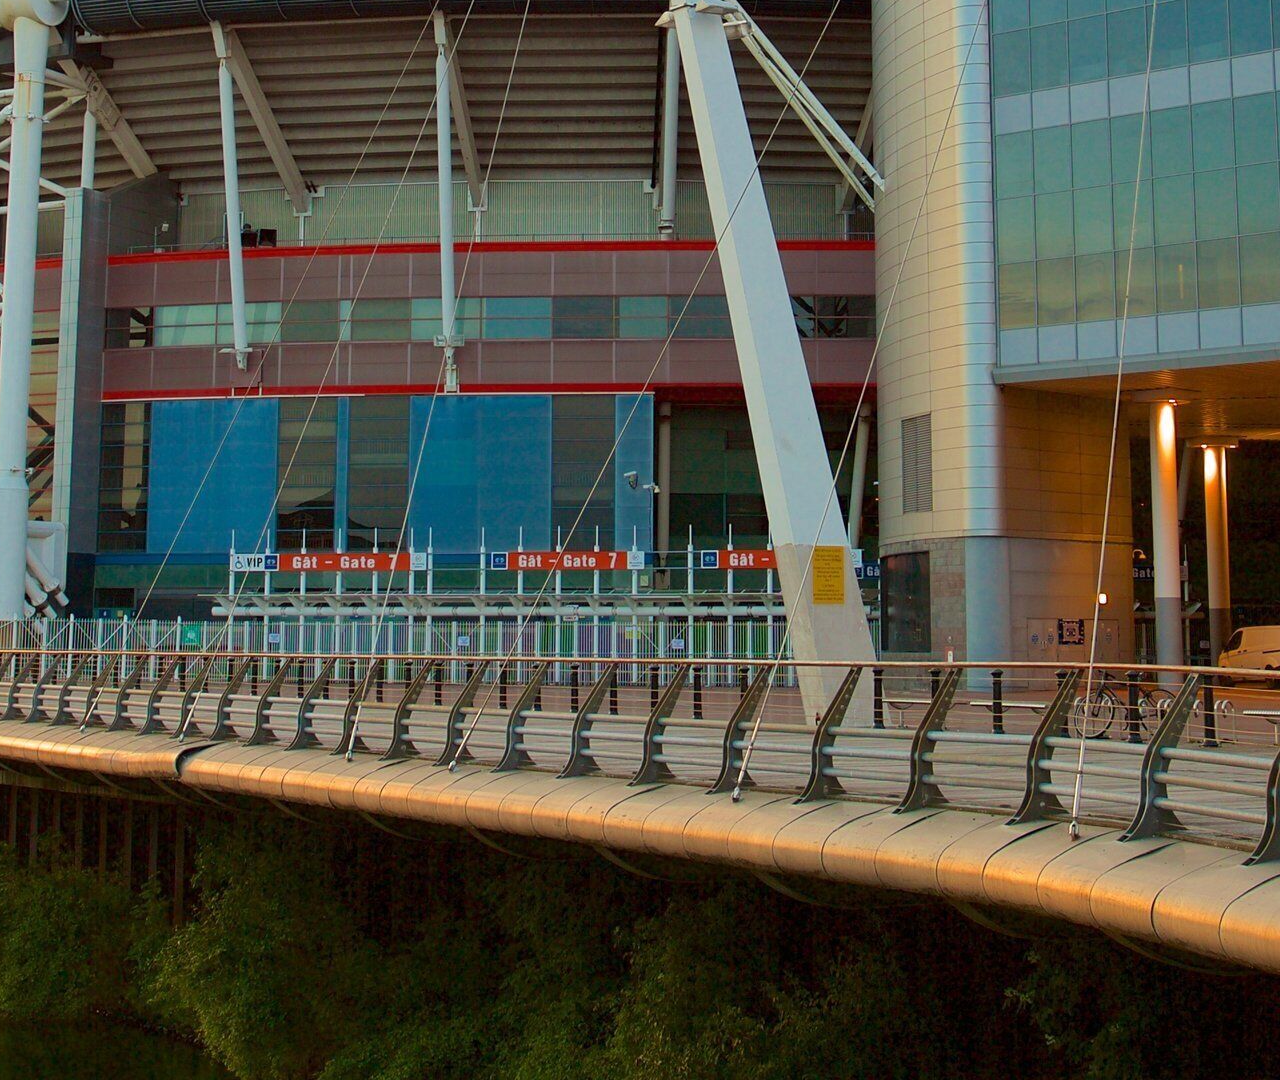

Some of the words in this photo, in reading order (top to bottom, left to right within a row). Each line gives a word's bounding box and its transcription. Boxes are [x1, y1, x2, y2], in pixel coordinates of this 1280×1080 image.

[247, 557, 263, 568] VIP
[293, 556, 318, 569] Gât
[340, 556, 376, 569] Gate
[389, 554, 398, 570] 7
[518, 554, 542, 567] Gât
[563, 554, 596, 567] Gate
[608, 553, 617, 568] 7
[729, 553, 754, 566] Gât
[866, 566, 880, 576] Gâ
